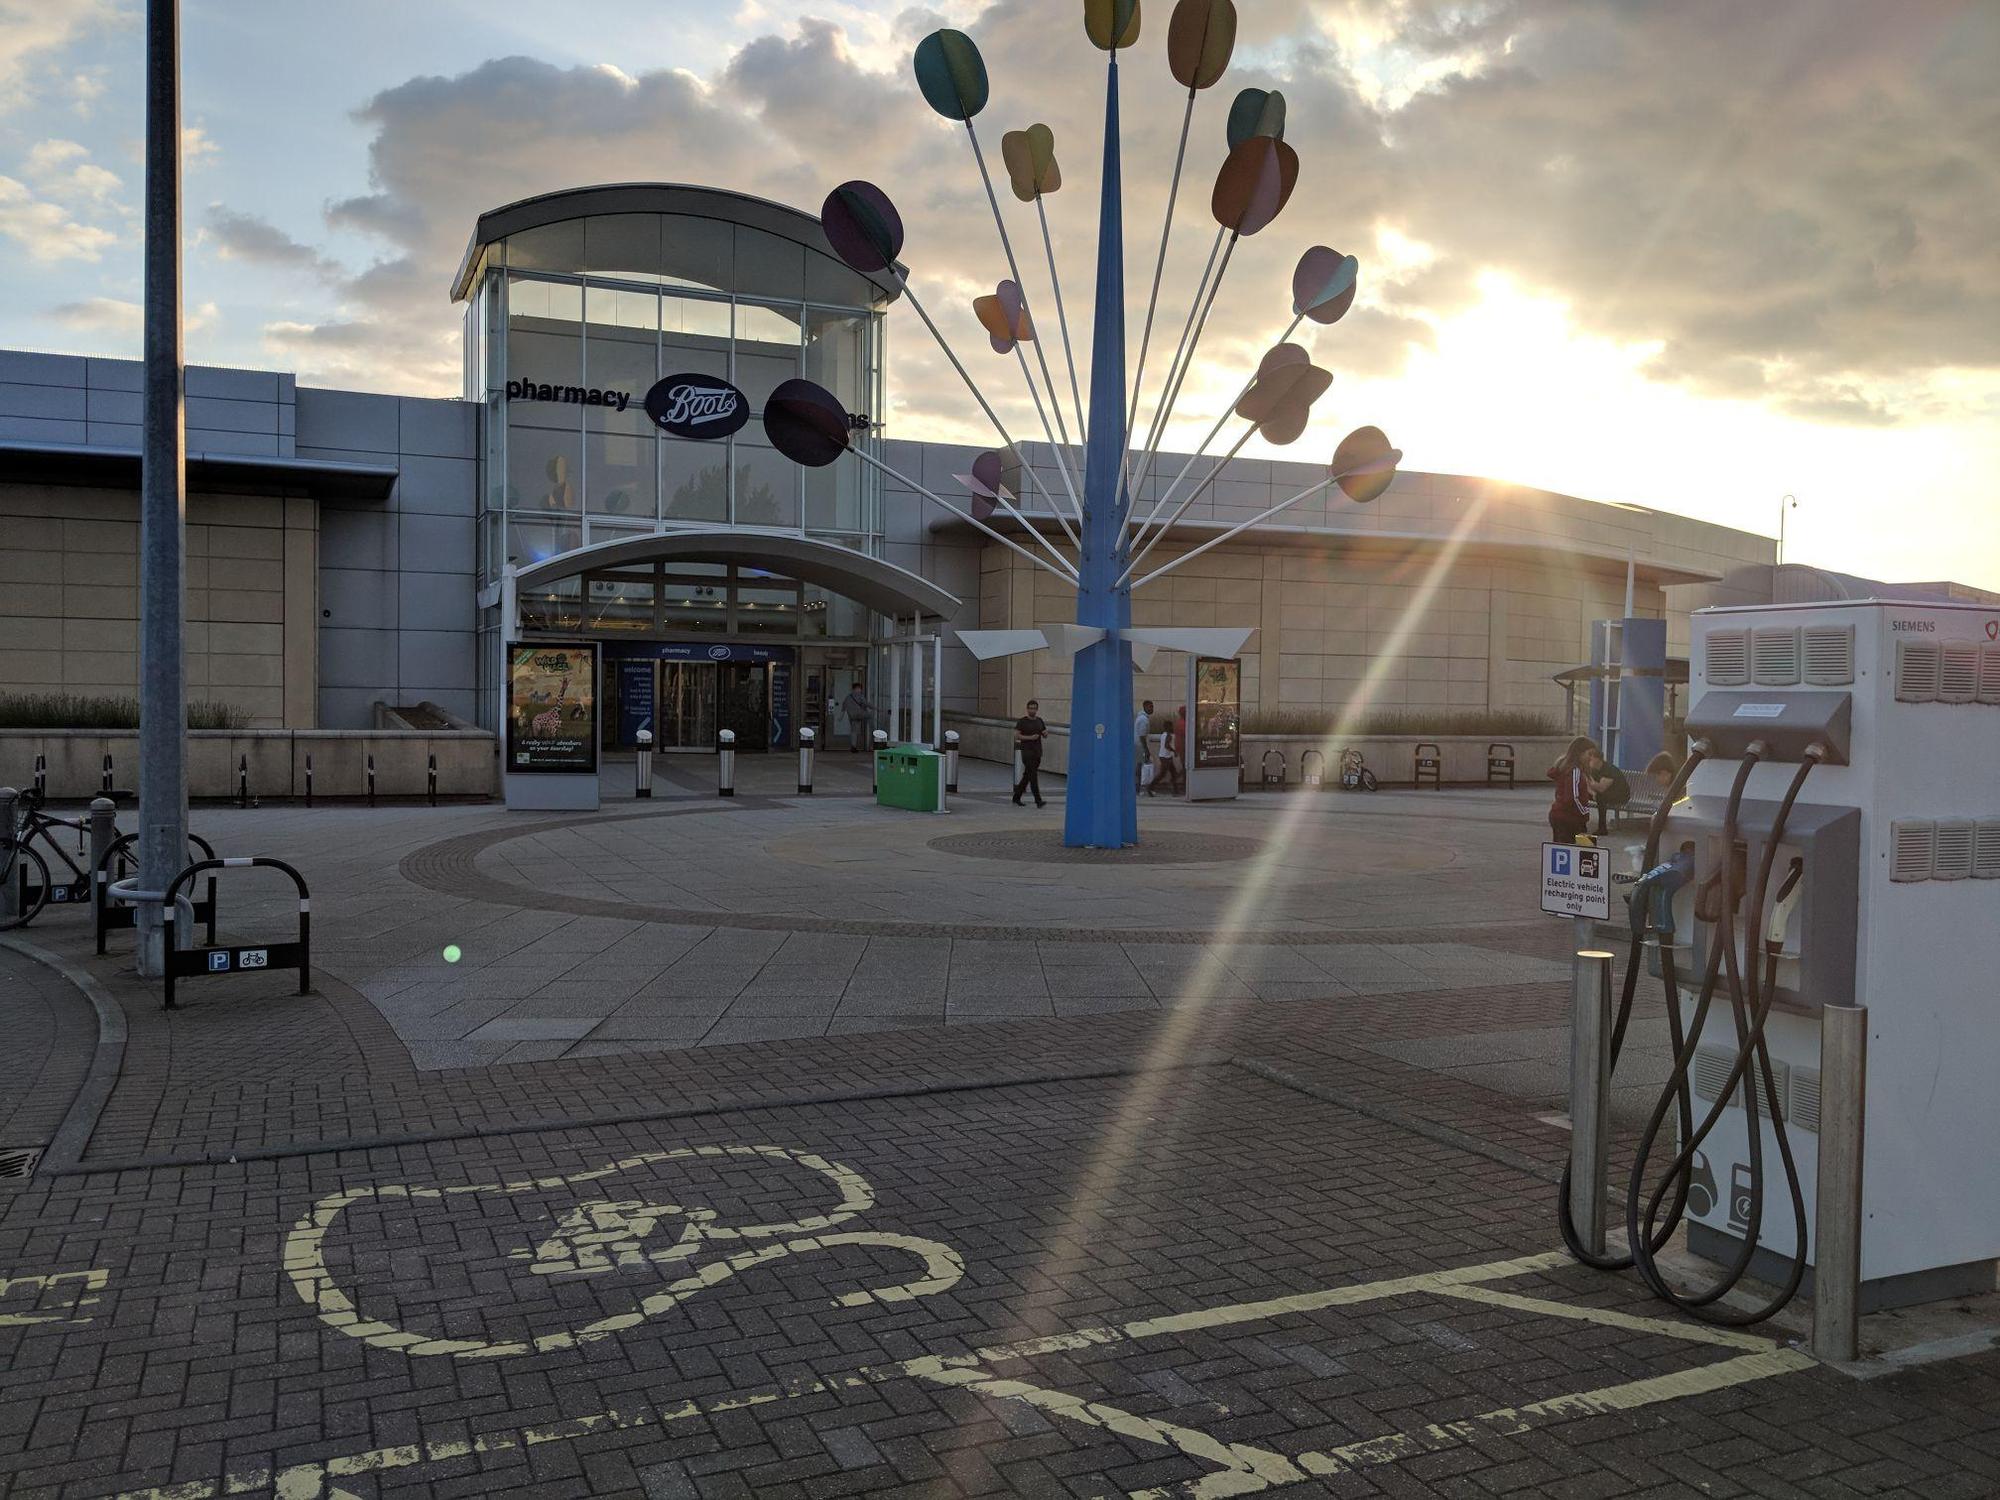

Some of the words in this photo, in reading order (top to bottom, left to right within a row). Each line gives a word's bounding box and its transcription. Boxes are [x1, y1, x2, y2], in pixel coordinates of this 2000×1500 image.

[506, 377, 630, 411] pharmacy
[660, 384, 737, 425] Boots
[1892, 621, 1936, 632] SIEMENS
[662, 648, 690, 656] pharmacy
[1556, 851, 1568, 872] P
[1547, 878, 1575, 889] Electric
[1577, 882, 1604, 893] vehicle
[55, 888, 65, 900] P
[1544, 889, 1584, 902] recharging
[1585, 895, 1606, 904] point
[1566, 902, 1582, 912] only
[213, 954, 227, 969] P
